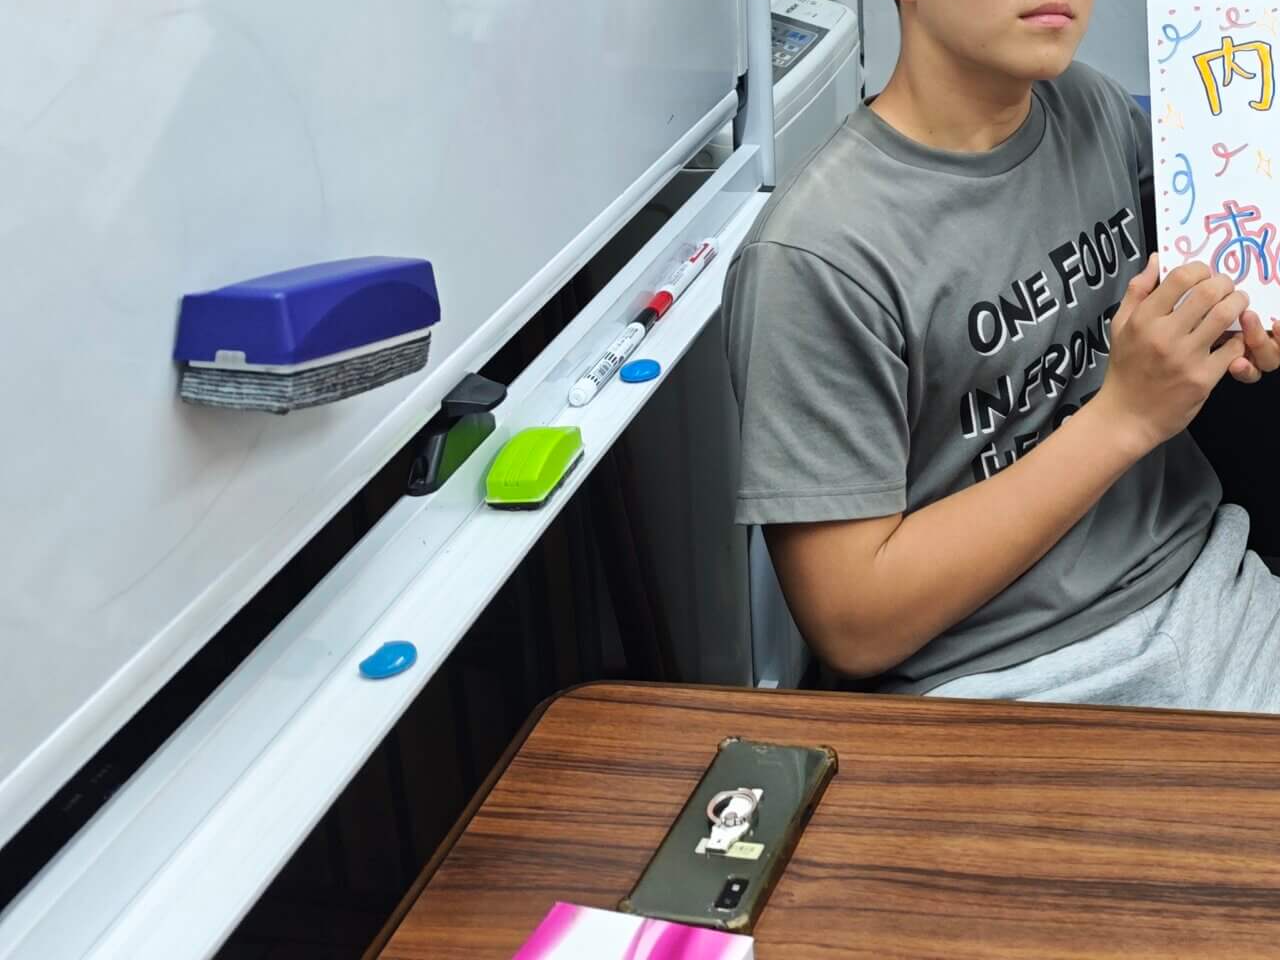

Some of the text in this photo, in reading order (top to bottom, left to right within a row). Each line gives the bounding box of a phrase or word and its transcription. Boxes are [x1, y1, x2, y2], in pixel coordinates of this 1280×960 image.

[968, 207, 1140, 356] ONE FOOT
[960, 375, 1013, 439] IN
